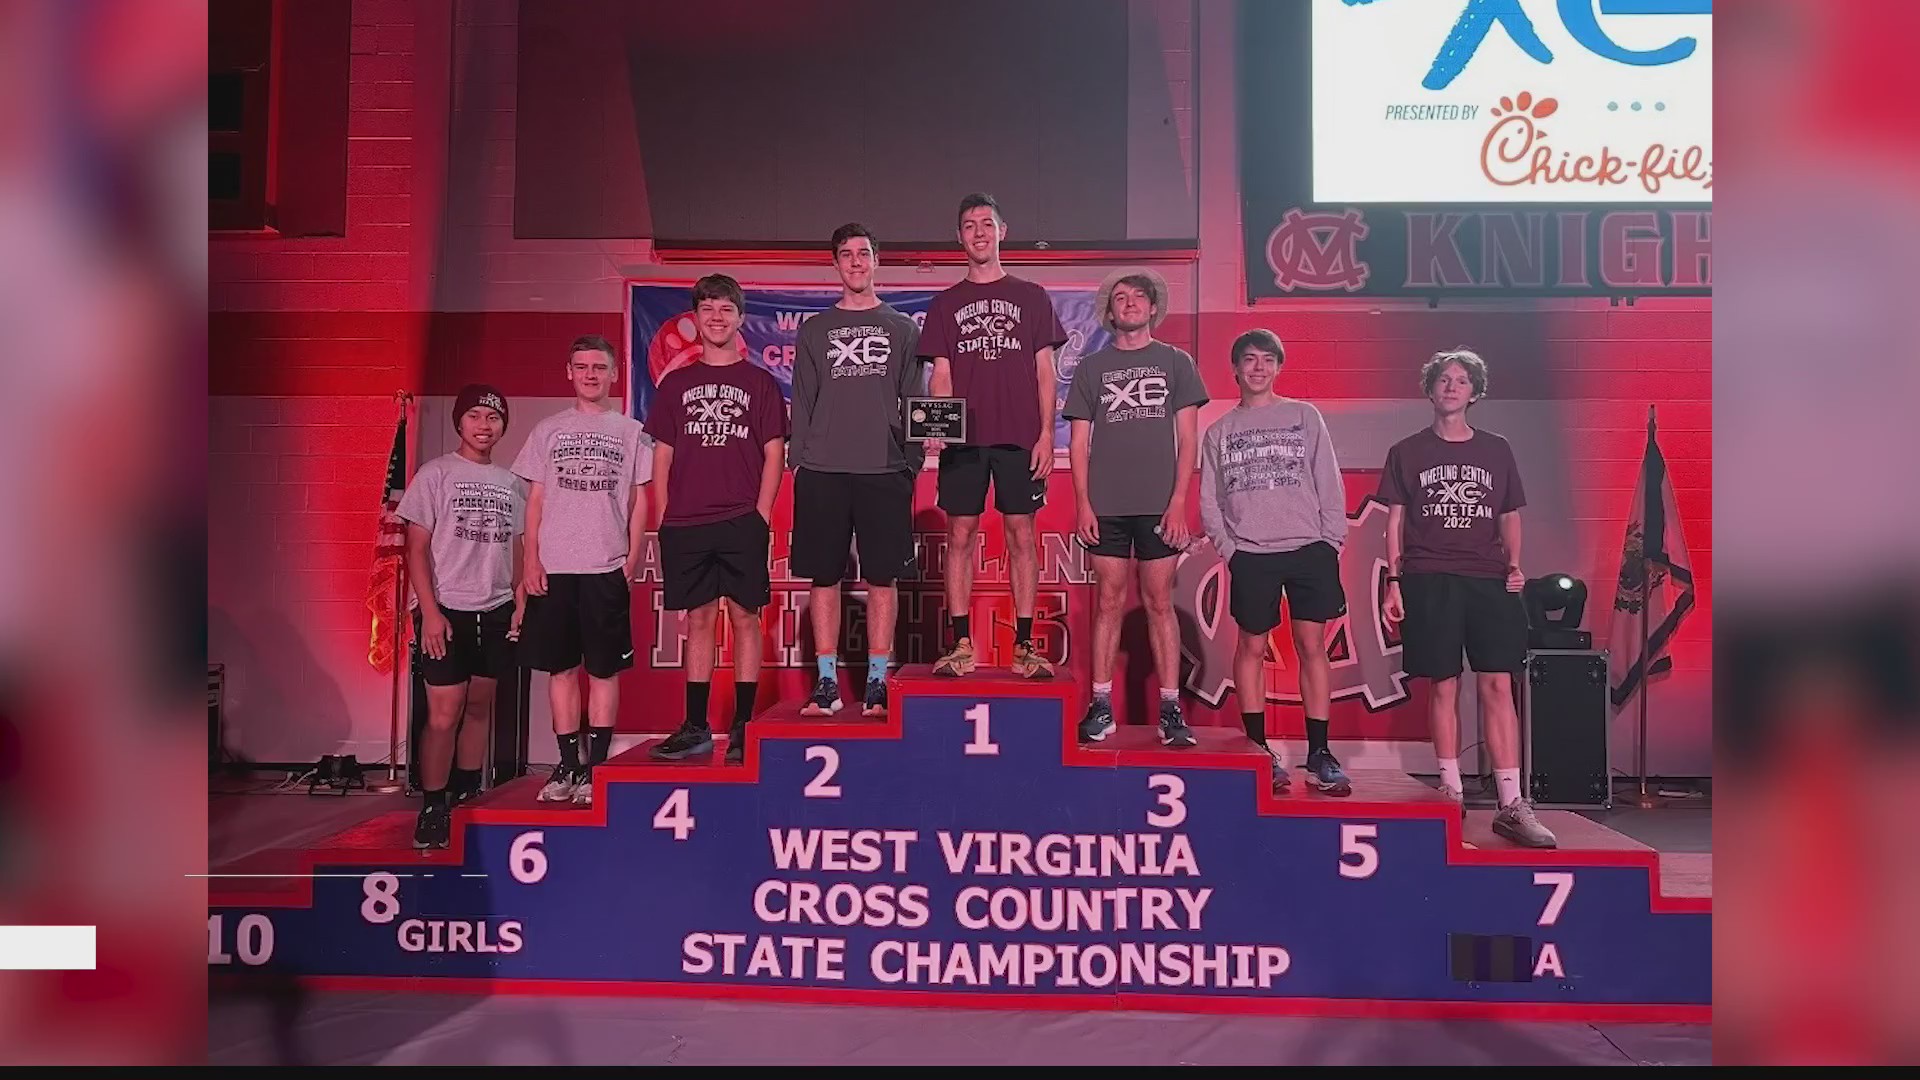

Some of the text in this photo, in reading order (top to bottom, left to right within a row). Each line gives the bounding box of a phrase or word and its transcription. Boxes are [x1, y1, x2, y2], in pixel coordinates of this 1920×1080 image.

[1385, 104, 1479, 121] PRESENTED BY
[1480, 113, 1712, 194] Chick-fil
[1401, 210, 1712, 288] KNIGH
[954, 300, 989, 326] WHEELING
[991, 299, 1021, 323] CENTRAL
[827, 325, 890, 340] CENTRAL
[957, 336, 1021, 354] STATE TEAM
[828, 335, 891, 367] XC
[1102, 366, 1167, 383] CENTRAL
[682, 384, 752, 411] WHEELING CENTRAL
[697, 399, 735, 422] XC
[1104, 377, 1167, 412] XC
[716, 421, 749, 439] TEAM
[1420, 464, 1494, 491] WHEELING CENTRAL
[1439, 480, 1479, 504] XC
[1422, 504, 1494, 519] STATE TEAM
[1443, 516, 1472, 529] 2022
[963, 703, 999, 754] 1
[804, 745, 841, 797] 2
[653, 789, 695, 840] 4
[1147, 775, 1186, 828] 3
[508, 830, 549, 884] 6
[769, 828, 1200, 877] WEST VIRGINIA
[1339, 824, 1378, 878] 5
[360, 870, 401, 924] 8
[753, 880, 1212, 931] CROSS COUNTRY
[1533, 872, 1573, 925] 7
[208, 914, 275, 966] 10
[397, 918, 524, 954] GIRLS
[682, 932, 1291, 988] STATE CHAMPIONSHIP
[1533, 944, 1564, 977] A
